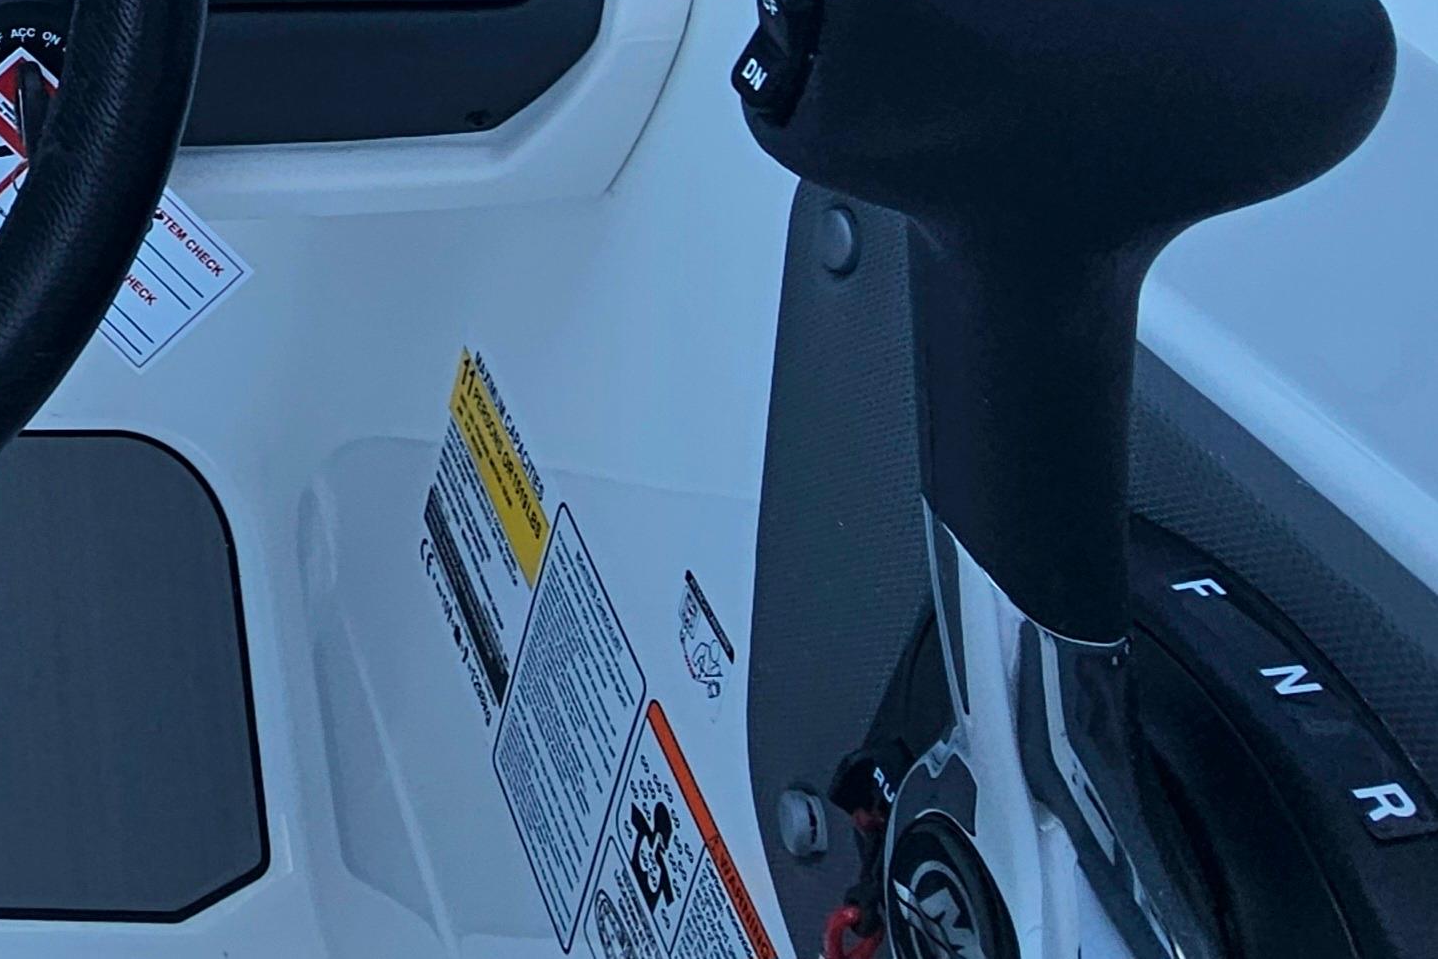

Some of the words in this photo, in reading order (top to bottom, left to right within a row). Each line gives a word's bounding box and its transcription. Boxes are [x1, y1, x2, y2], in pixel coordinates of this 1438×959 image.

[10, 27, 36, 39] ACC
[42, 31, 61, 46] ON
[741, 57, 768, 91] DN
[184, 238, 225, 278] CHECK
[124, 273, 158, 306] HECK
[1171, 577, 1227, 597] F
[1260, 664, 1322, 695] N
[1352, 782, 1417, 822] R
